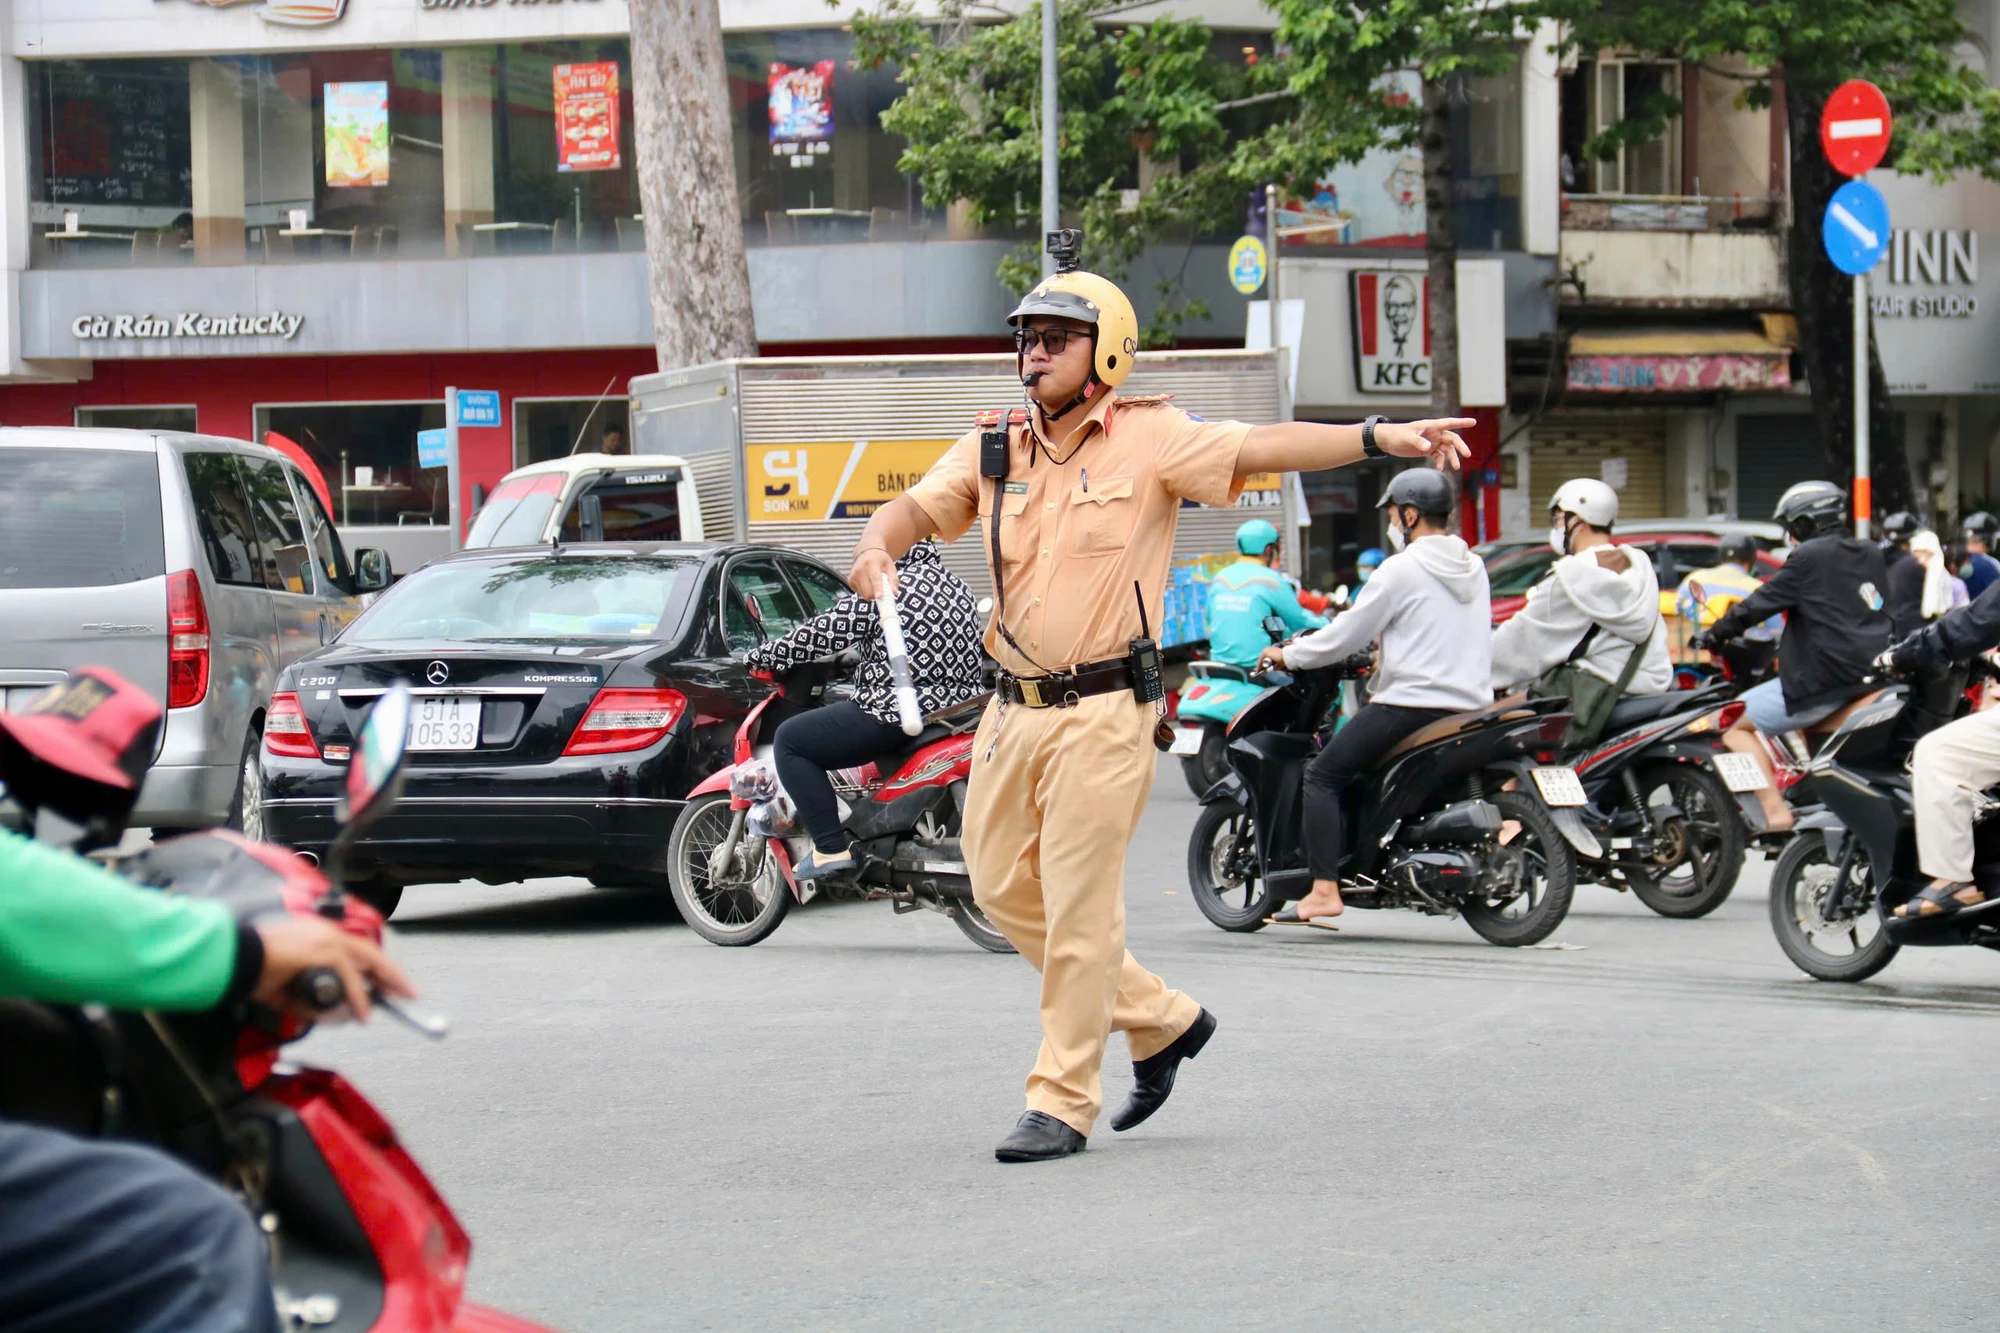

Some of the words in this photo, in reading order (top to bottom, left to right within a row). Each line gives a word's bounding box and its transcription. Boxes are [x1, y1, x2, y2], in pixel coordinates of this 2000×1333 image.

[1916, 294, 1979, 317] STUDIO
[71, 314, 110, 339] Gà
[112, 313, 171, 338] Rán
[173, 310, 304, 341] Kentucky
[1374, 361, 1429, 386] KFC
[625, 473, 667, 485] ISUZU
[299, 677, 308, 687] C
[308, 676, 336, 687] 200
[524, 674, 598, 683] KOMPRESSOR
